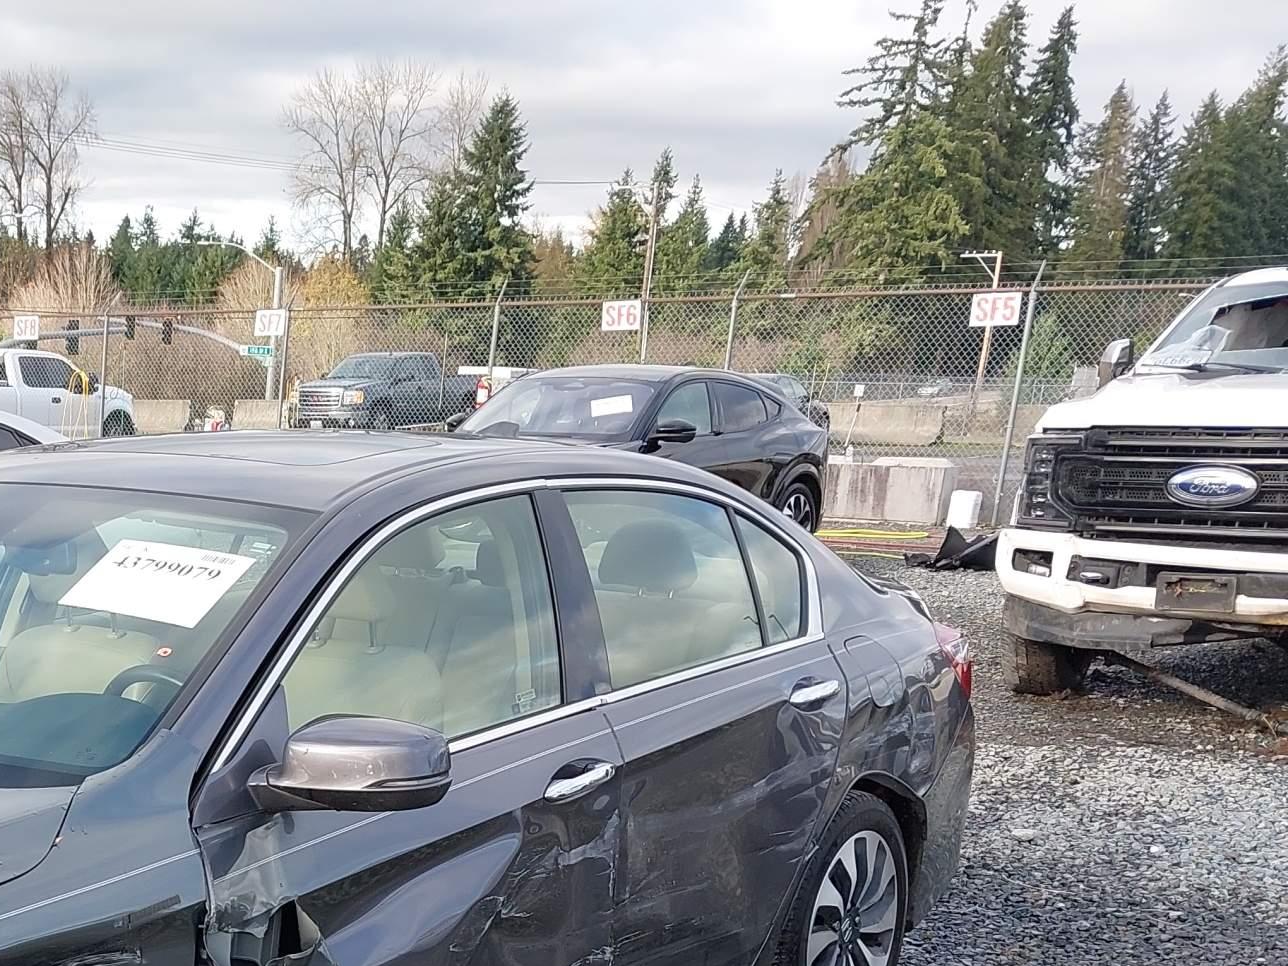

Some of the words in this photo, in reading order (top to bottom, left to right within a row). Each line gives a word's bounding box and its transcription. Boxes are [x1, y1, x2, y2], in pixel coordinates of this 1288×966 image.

[605, 304, 638, 327] SF6
[975, 296, 1018, 322] SF5
[16, 318, 36, 337] SF8
[258, 312, 282, 333] SF7
[111, 554, 222, 582] 43799079
